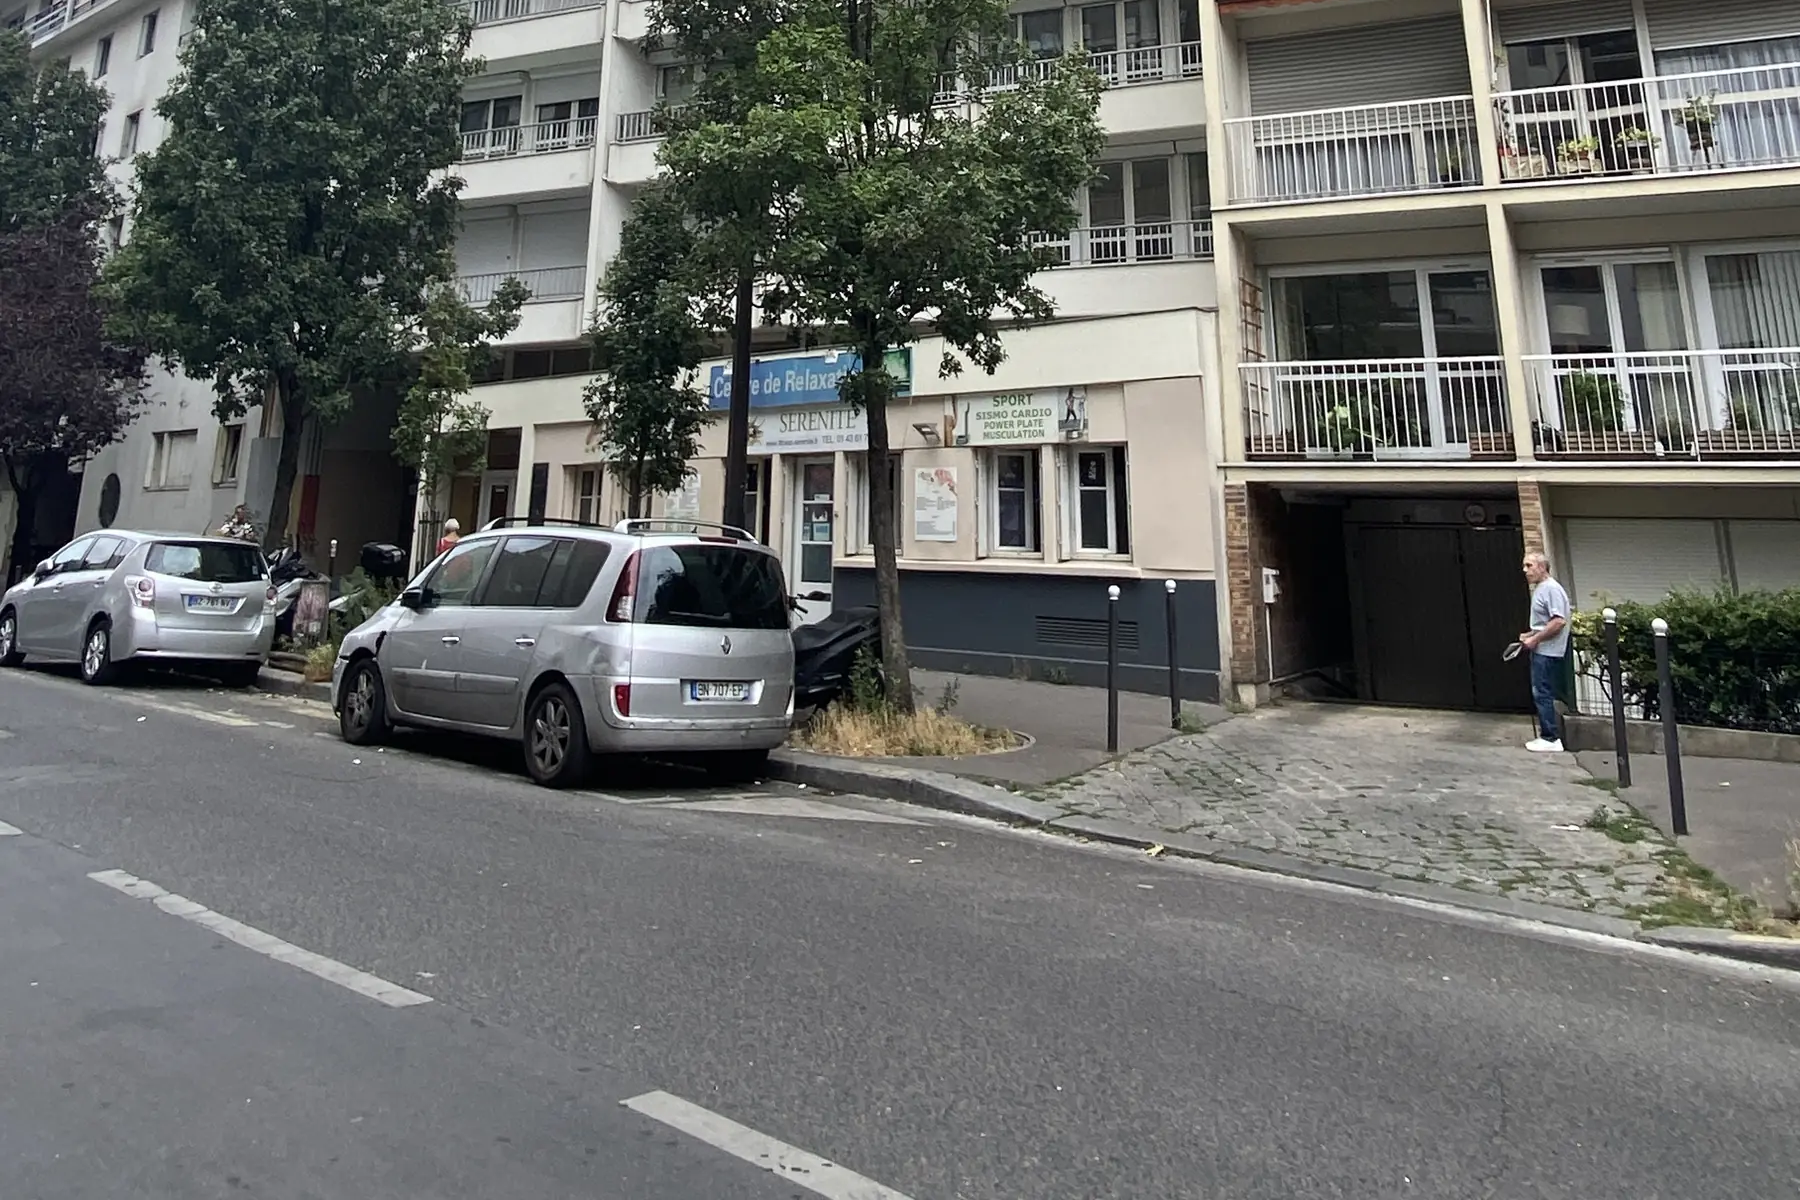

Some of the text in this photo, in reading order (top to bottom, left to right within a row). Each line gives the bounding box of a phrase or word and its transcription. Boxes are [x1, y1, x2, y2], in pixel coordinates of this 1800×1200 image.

[764, 374, 781, 395] de
[992, 393, 1034, 408] SPORT
[975, 408, 1053, 421] SISMO CARDIO
[983, 419, 1044, 430] POWER PLATE
[982, 429, 1045, 440] MUSCULATION
